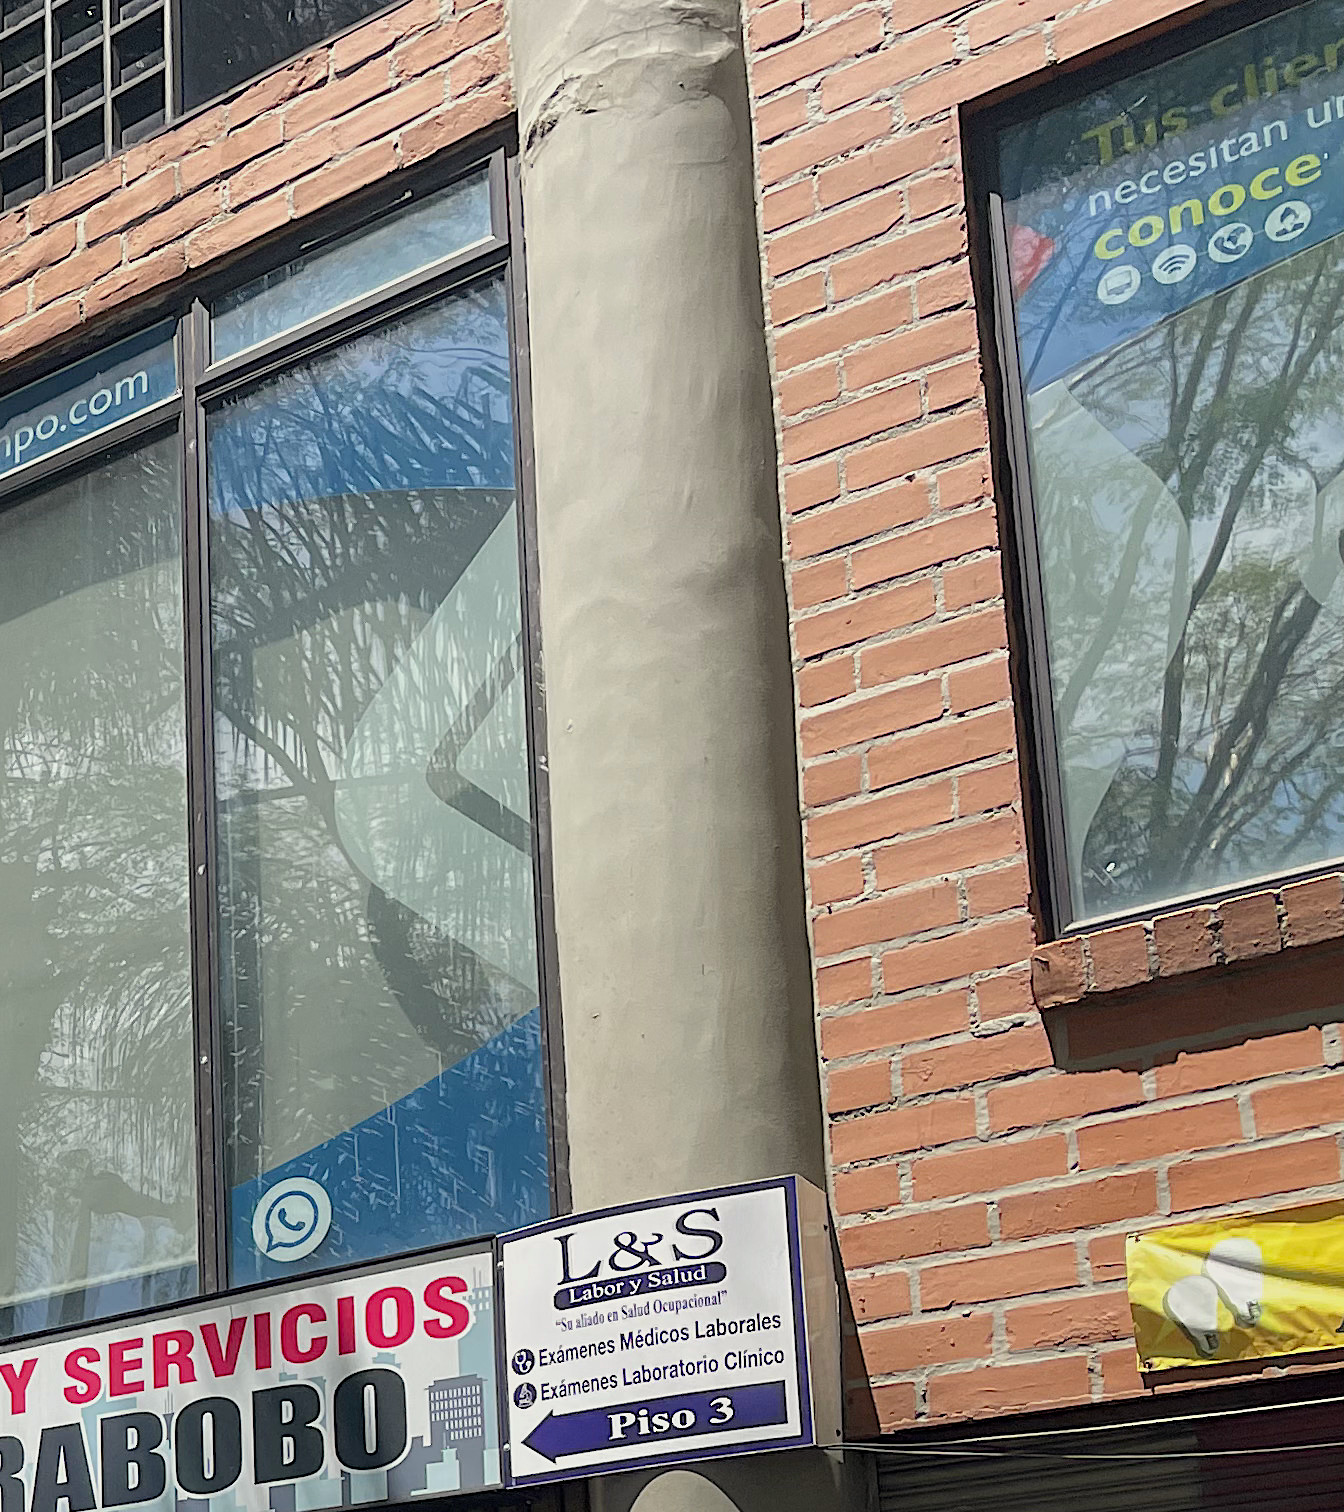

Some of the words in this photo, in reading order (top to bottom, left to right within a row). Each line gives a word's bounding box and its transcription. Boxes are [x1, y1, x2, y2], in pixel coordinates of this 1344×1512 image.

[1089, 117, 1287, 216] necesitan
[1093, 153, 1321, 259] conoce
[554, 1208, 723, 1285] L&S
[569, 1282, 624, 1304] Labor
[629, 1279, 641, 1296] y
[648, 1265, 707, 1289] Salud
[64, 1276, 470, 1404] SERVICIOS
[539, 1337, 615, 1367] Exámenes
[620, 1324, 689, 1351] Médicos
[695, 1313, 782, 1339] Laborales
[575, 1310, 605, 1329] aliado
[607, 1310, 619, 1323] en
[621, 1299, 650, 1319] Salud
[541, 1372, 618, 1401] Exámenes
[623, 1354, 719, 1386] Laboratorio
[724, 1348, 785, 1371] Clínico
[607, 1407, 696, 1441] Piso
[710, 1397, 734, 1425] 3
